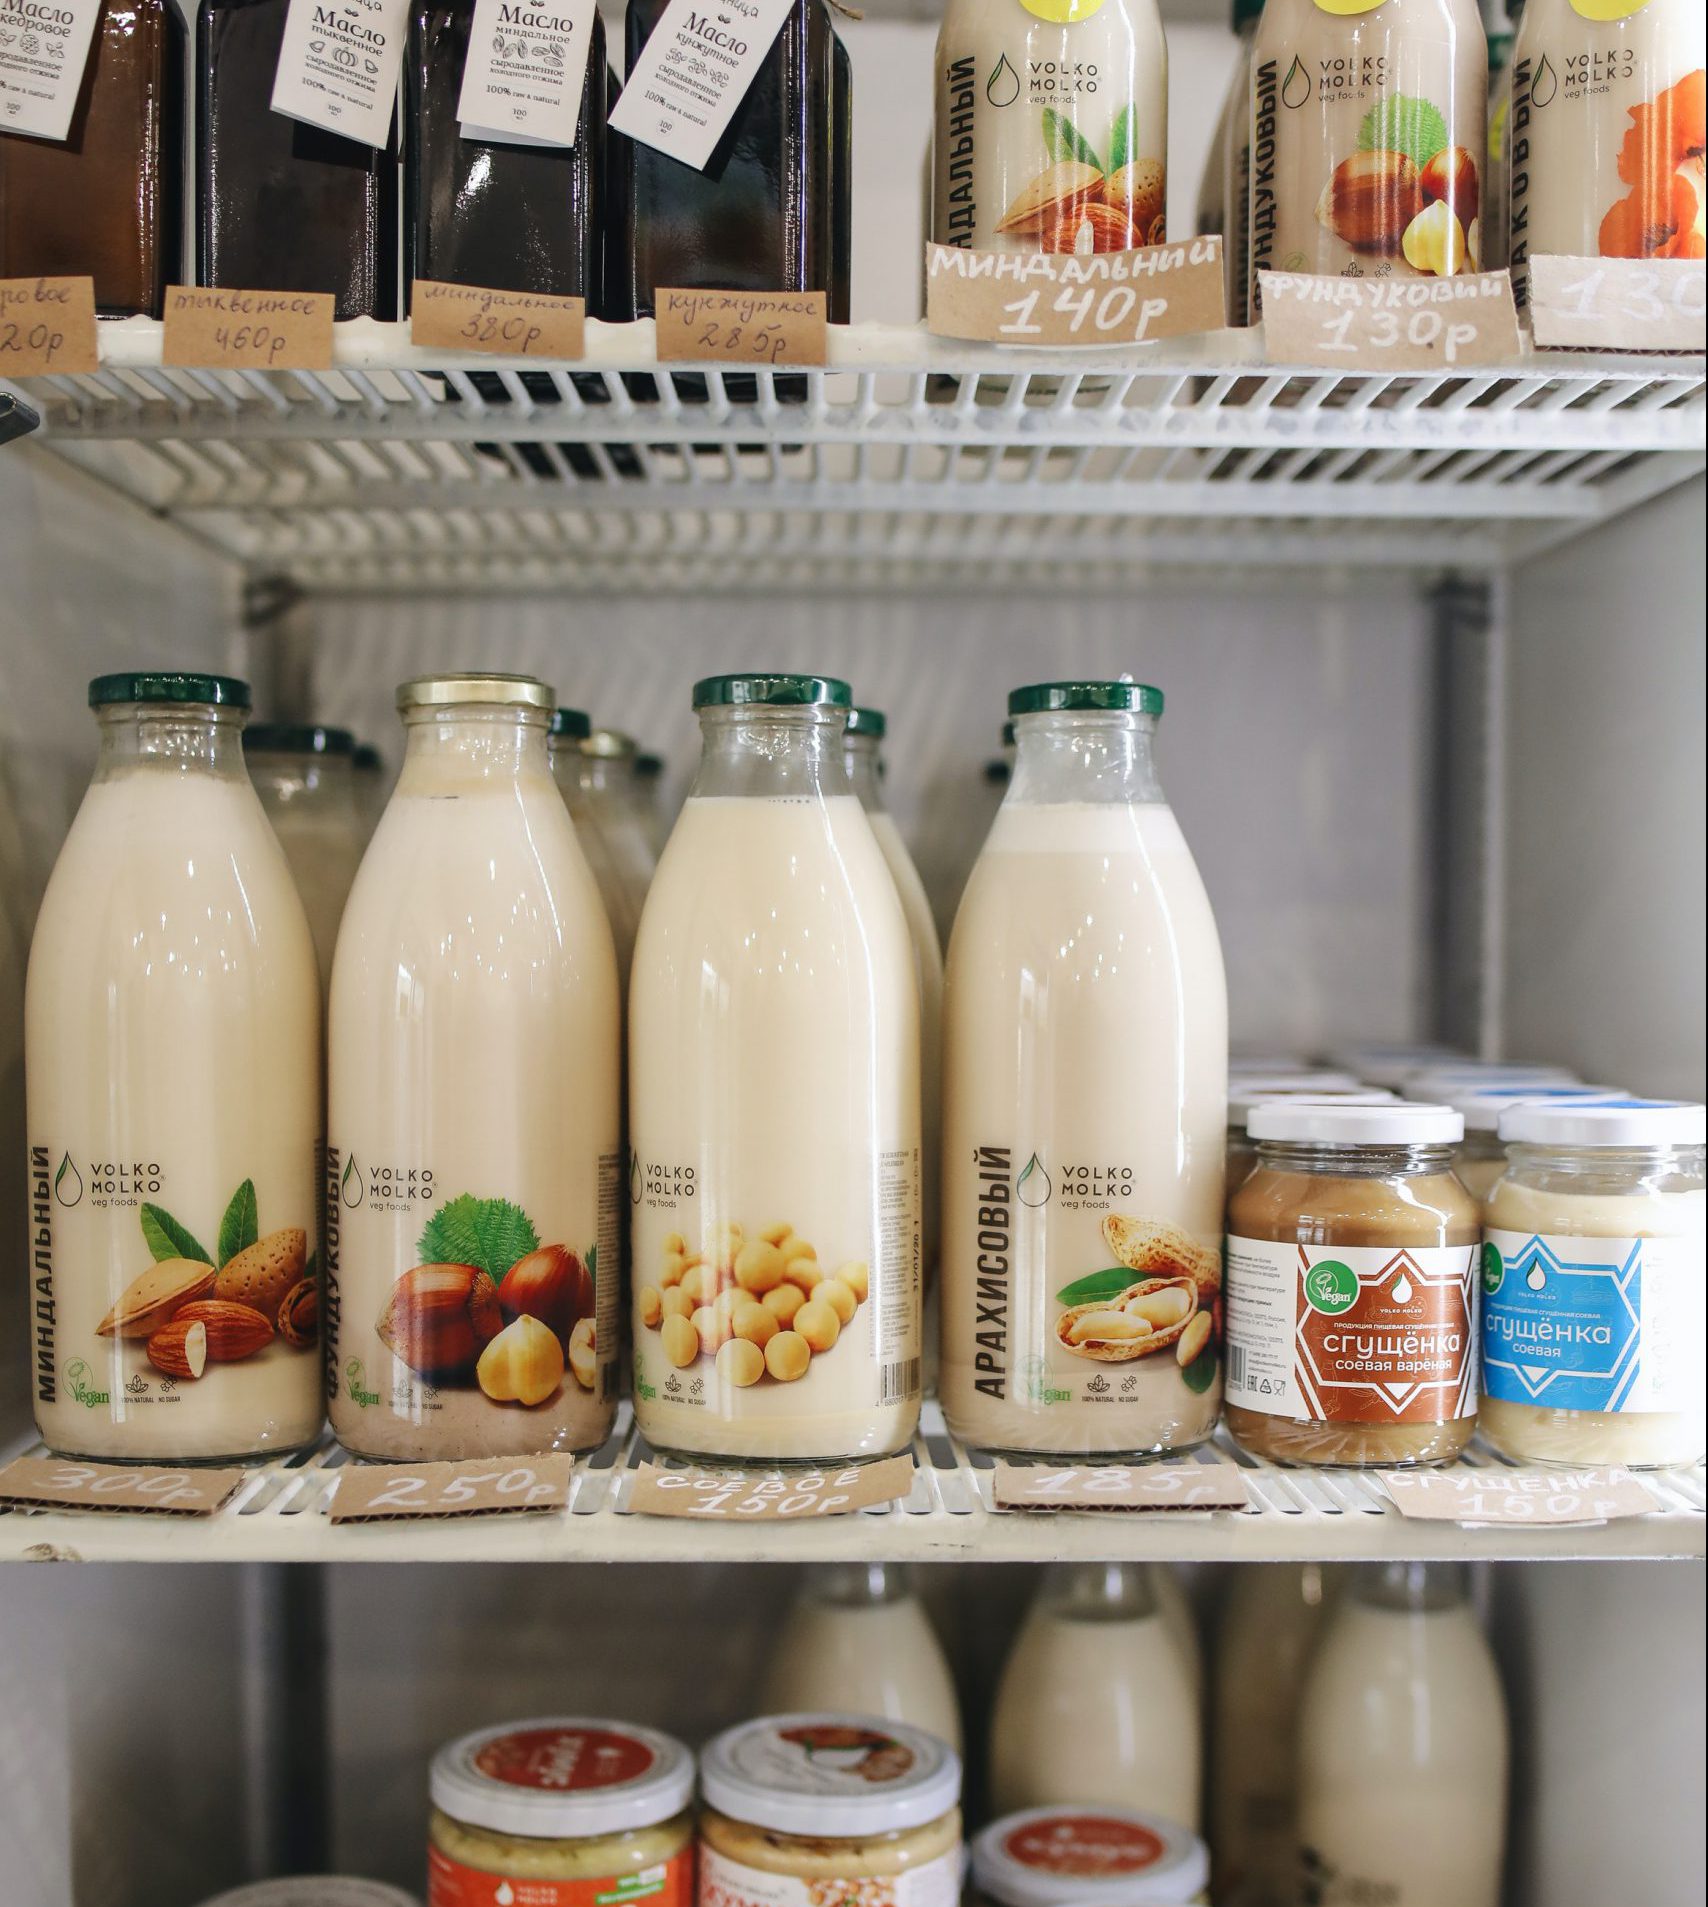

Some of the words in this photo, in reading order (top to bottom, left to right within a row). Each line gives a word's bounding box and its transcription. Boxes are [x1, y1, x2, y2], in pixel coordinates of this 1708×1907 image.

[2, 0, 74, 25] Масло
[498, 3, 573, 33] Масло
[721, 0, 759, 18] ница
[0, 13, 71, 37] кедровое
[312, 5, 386, 46] Масло
[682, 11, 748, 56] Масло
[311, 24, 383, 57] тыквенное
[495, 26, 571, 44] миндальное
[675, 31, 739, 69] кунжутное
[1565, 49, 1634, 69] VOLKO
[306, 54, 378, 85] сыродавленное
[490, 59, 565, 77] сыродавленное
[1029, 61, 1098, 77] VOLKO
[1320, 56, 1389, 72] VOLKO
[302, 76, 327, 92] 100%
[532, 74, 563, 86] отжима
[658, 63, 722, 99] сыродавленное
[1319, 73, 1389, 90] MOLKO
[1565, 66, 1633, 86] MOLKO
[1029, 78, 1098, 93] MOLKO
[1564, 90, 1581, 100] veg
[1583, 85, 1610, 96] foods
[486, 84, 512, 96] 100%
[533, 95, 561, 106] natural
[1029, 95, 1046, 105] veg
[1049, 94, 1077, 105] foods
[328, 104, 342, 114] 100
[512, 108, 527, 117] 100
[644, 90, 666, 106] 100%
[682, 109, 707, 127] natural
[659, 119, 673, 131] 100
[946, 56, 976, 250] НДАЛЬНЫЙ
[174, 290, 316, 315] тыквенное
[425, 286, 575, 312] миндальное
[669, 294, 818, 326] кунжутное
[460, 313, 542, 353] 380р
[215, 326, 286, 365] 460р
[91, 1163, 160, 1177] VOLKO
[370, 1167, 433, 1183] VOLKO
[646, 1163, 695, 1179] VOLKO
[1062, 1166, 1133, 1179] VOLKO
[91, 1180, 161, 1194] MOLKO
[370, 1185, 433, 1199] MOLKO
[646, 1181, 695, 1197] MOLKO
[1062, 1184, 1132, 1196] MOLKO
[91, 1198, 107, 1208] veg
[110, 1198, 138, 1207] foods
[369, 1202, 384, 1211] veg
[386, 1202, 411, 1211] foods
[647, 1199, 657, 1207] veg
[657, 1199, 677, 1208] foods
[1061, 1201, 1079, 1209] veg
[1082, 1200, 1110, 1209] foods
[30, 1146, 56, 1403] МИНДАЛЬНЫЙ
[974, 1146, 1011, 1401] АРАХИСОВЫЙ
[1318, 1286, 1352, 1305] Vegan
[1333, 1322, 1373, 1330] ПРОДУКЦИЯ
[1486, 1313, 1611, 1344] сгущёнка
[1323, 1332, 1460, 1359] сгущёнка
[1512, 1342, 1561, 1358] соевая
[1335, 1359, 1392, 1371] соевая
[1396, 1358, 1452, 1374] варёная
[72, 1385, 110, 1408] Vegan
